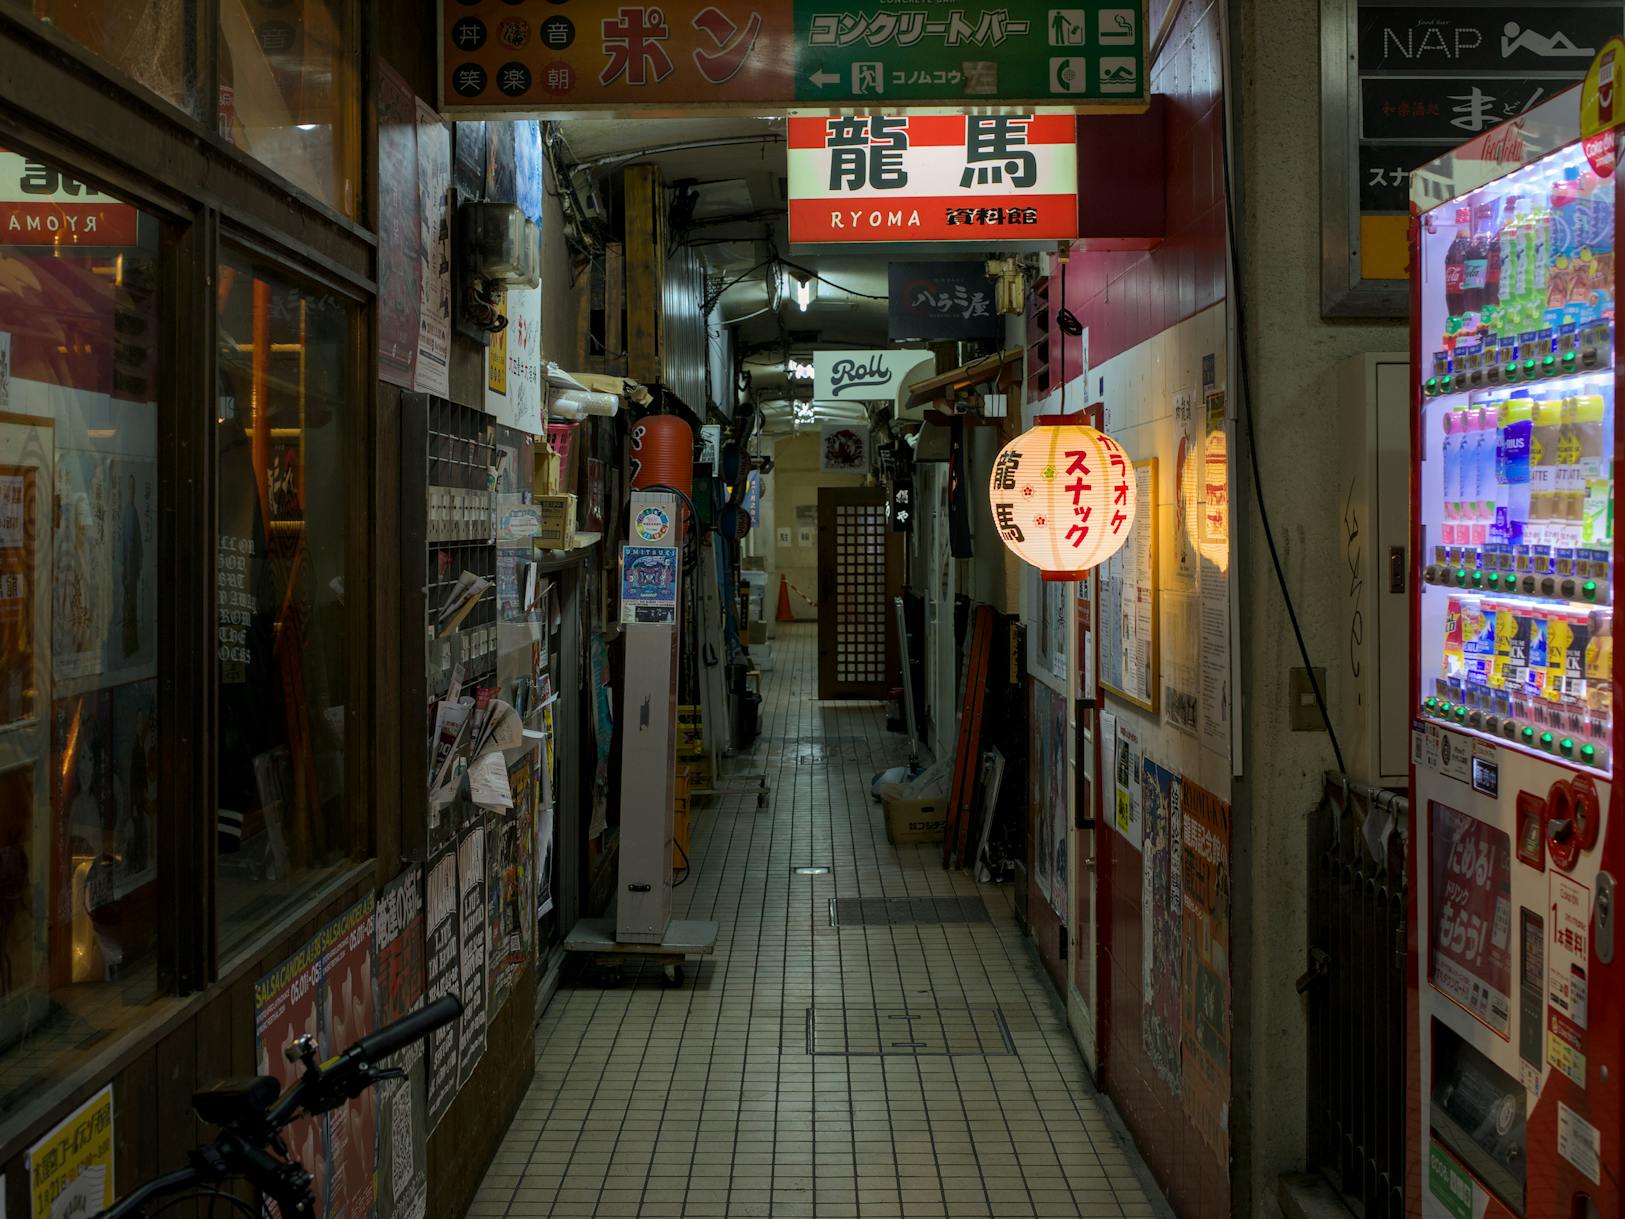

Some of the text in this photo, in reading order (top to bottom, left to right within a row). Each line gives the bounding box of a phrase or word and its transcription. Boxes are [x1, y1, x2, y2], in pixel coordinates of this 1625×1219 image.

[458, 22, 569, 45] 丼 音
[599, 6, 762, 85] ポン
[807, 8, 1032, 48] コンクリートバー
[1383, 28, 1482, 59] NAP
[459, 69, 569, 91] 笑 楽 朝
[892, 69, 961, 84] コノムコウ
[826, 115, 1037, 191] 龍馬
[831, 210, 921, 228] RYOMA
[831, 354, 892, 396] Roll
[994, 449, 1025, 543] 龍馬
[1064, 450, 1092, 548] スナック
[1096, 434, 1129, 535] カラオケ
